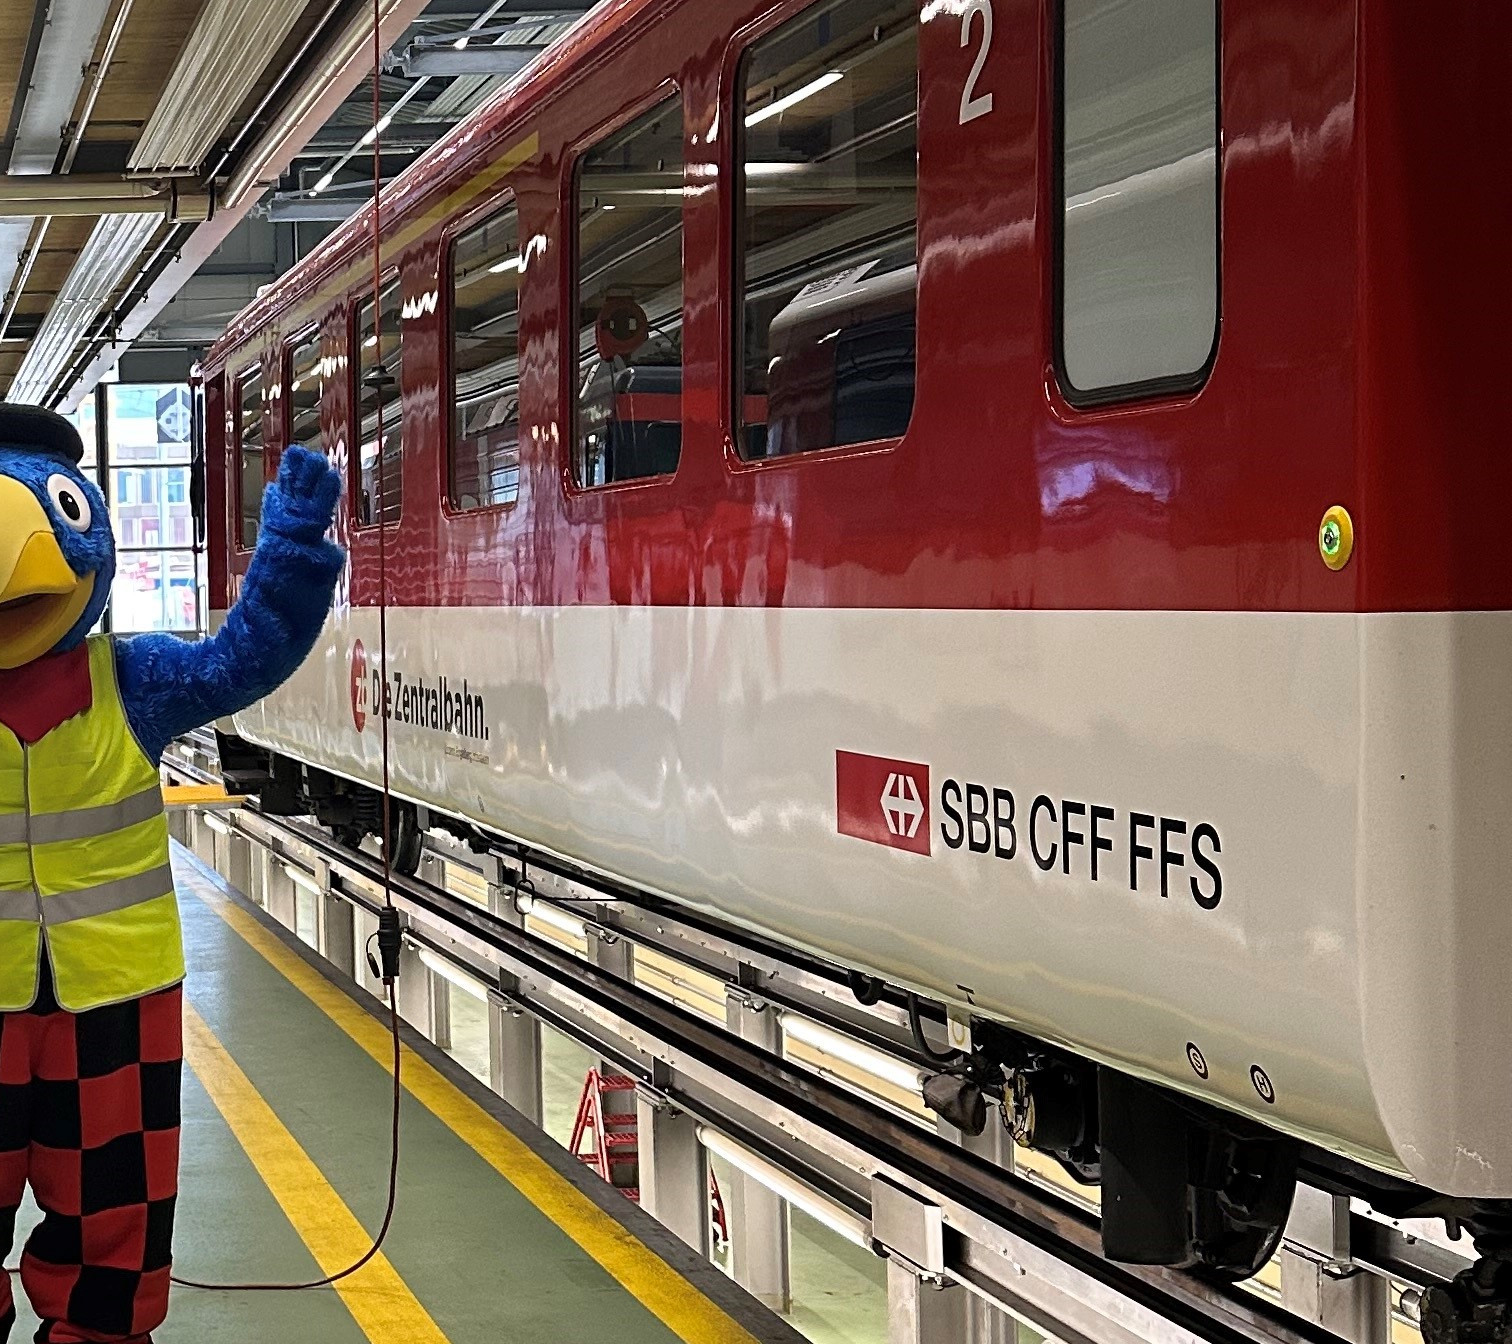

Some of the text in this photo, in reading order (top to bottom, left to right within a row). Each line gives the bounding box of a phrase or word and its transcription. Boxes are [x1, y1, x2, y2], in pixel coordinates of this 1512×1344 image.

[372, 668, 489, 741] De Zentralbahn.
[940, 778, 1222, 910] SBB CFF FFS
